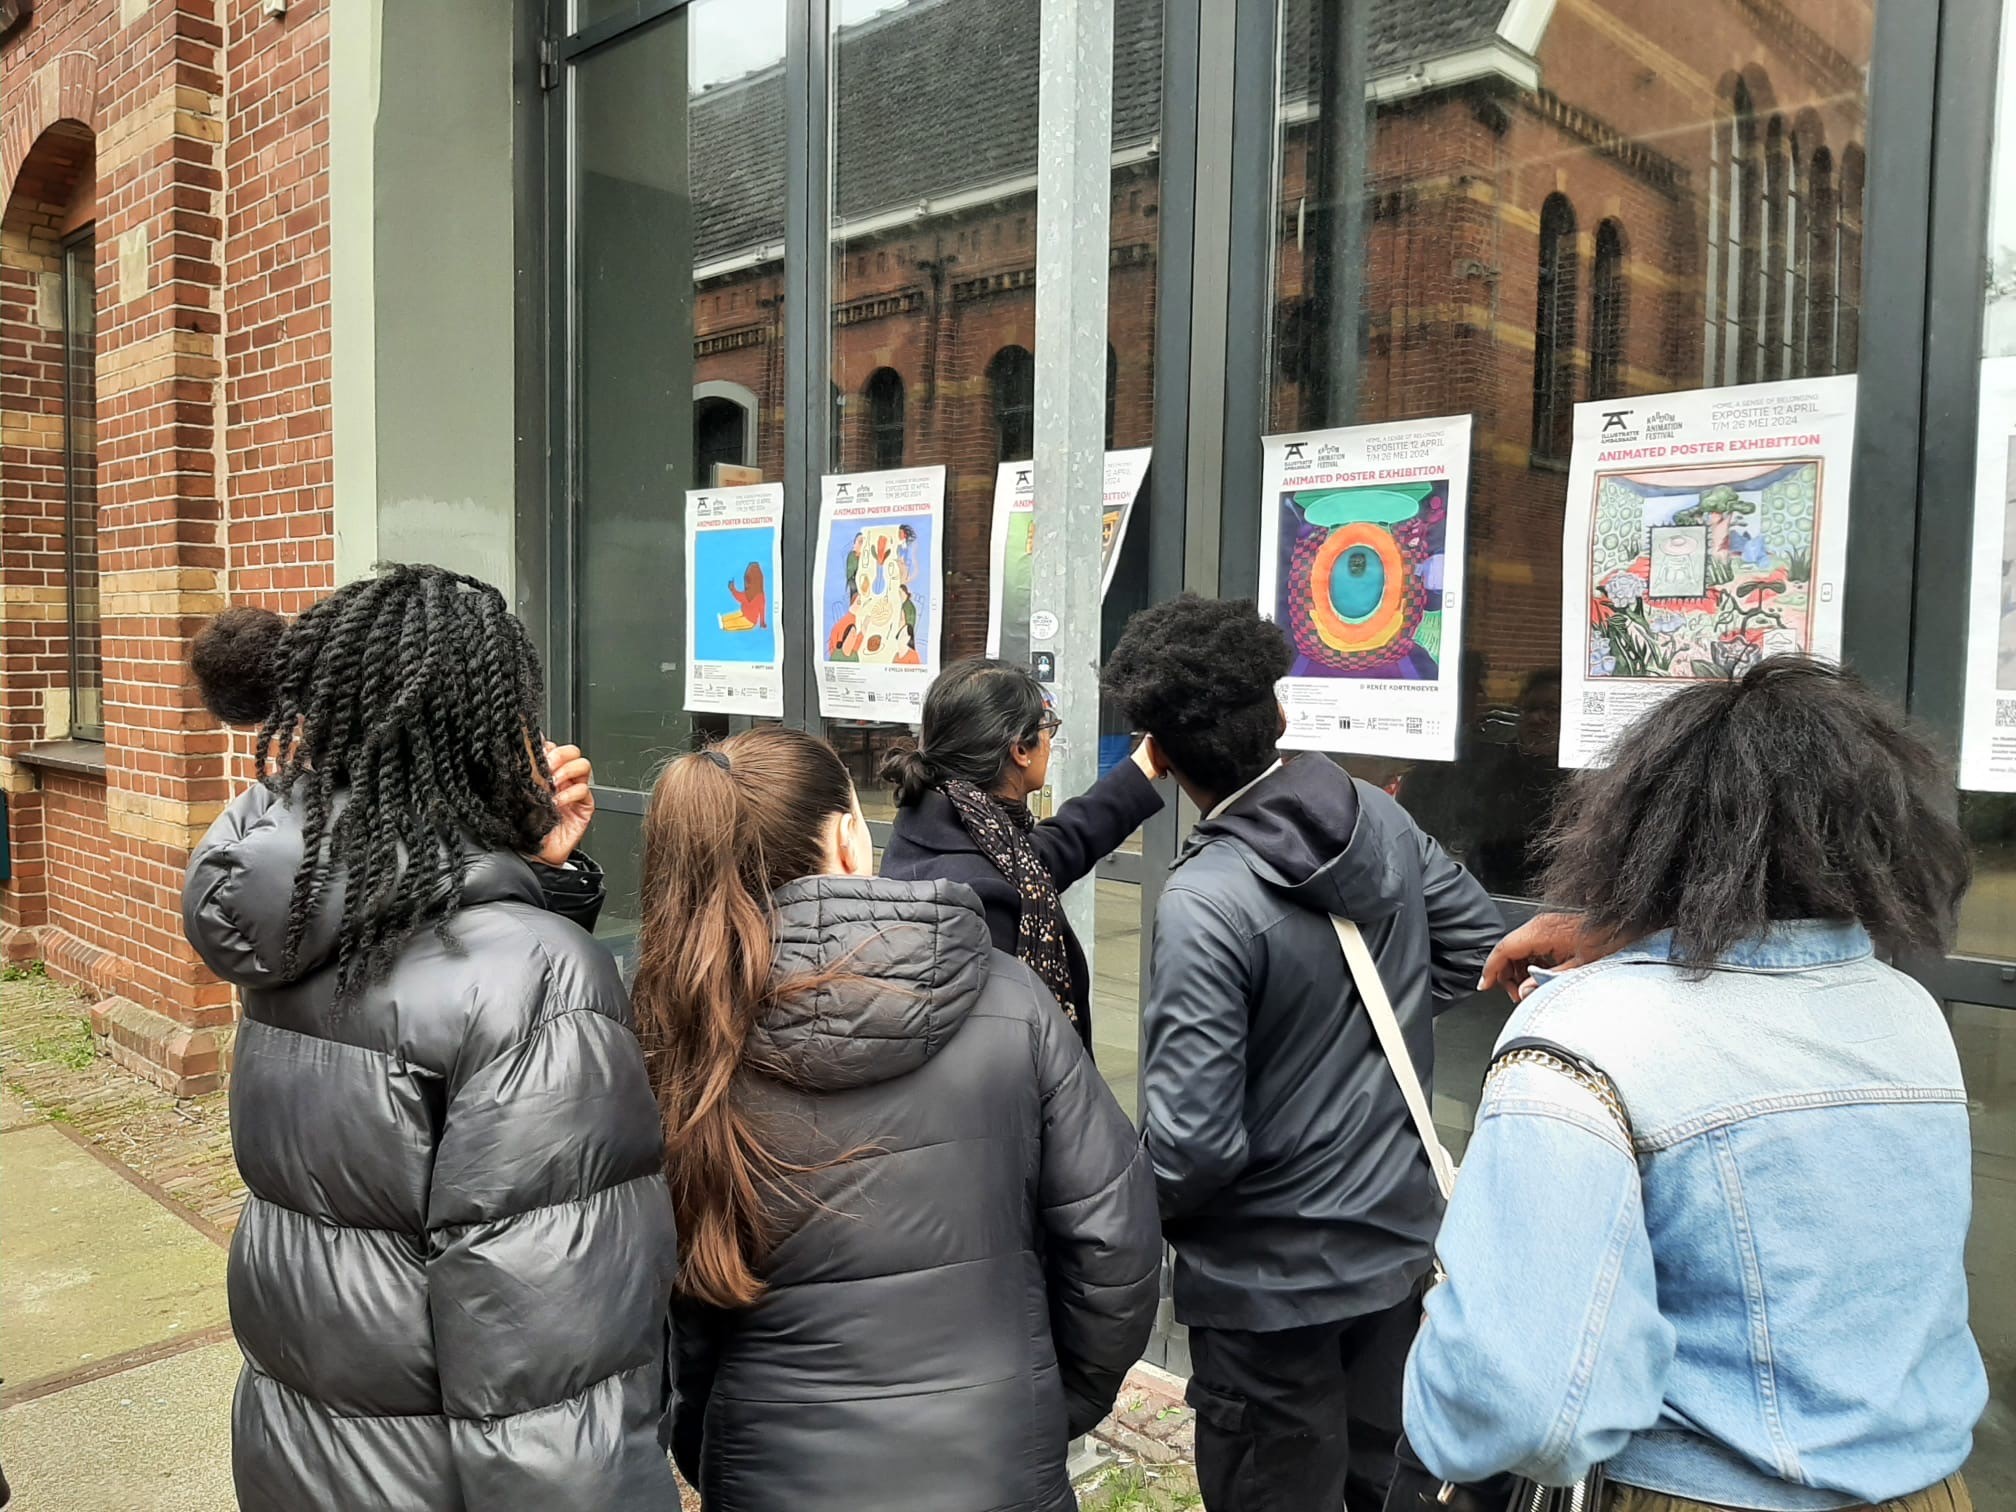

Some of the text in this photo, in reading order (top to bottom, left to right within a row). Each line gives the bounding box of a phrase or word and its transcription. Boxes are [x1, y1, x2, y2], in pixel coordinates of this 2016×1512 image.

[1712, 402, 1819, 421] EXPOSITIE 12 APRIL
[1646, 422, 1683, 432] ANIMATION
[1712, 416, 1798, 432] T/M 26 MEI 2024
[1645, 431, 1674, 440] FESTIVAL
[1366, 438, 1445, 453] EXPOSITIE 12 APRIL
[1598, 434, 1821, 462] ANIMATED POSTER EXHIBITION
[1393, 451, 1407, 460] MEI
[1409, 449, 1429, 458] 2024
[1282, 465, 1445, 487] ANIMATED POSTER EXHIBITION
[833, 503, 931, 516] ANIMATED POSTER EXHIBITION
